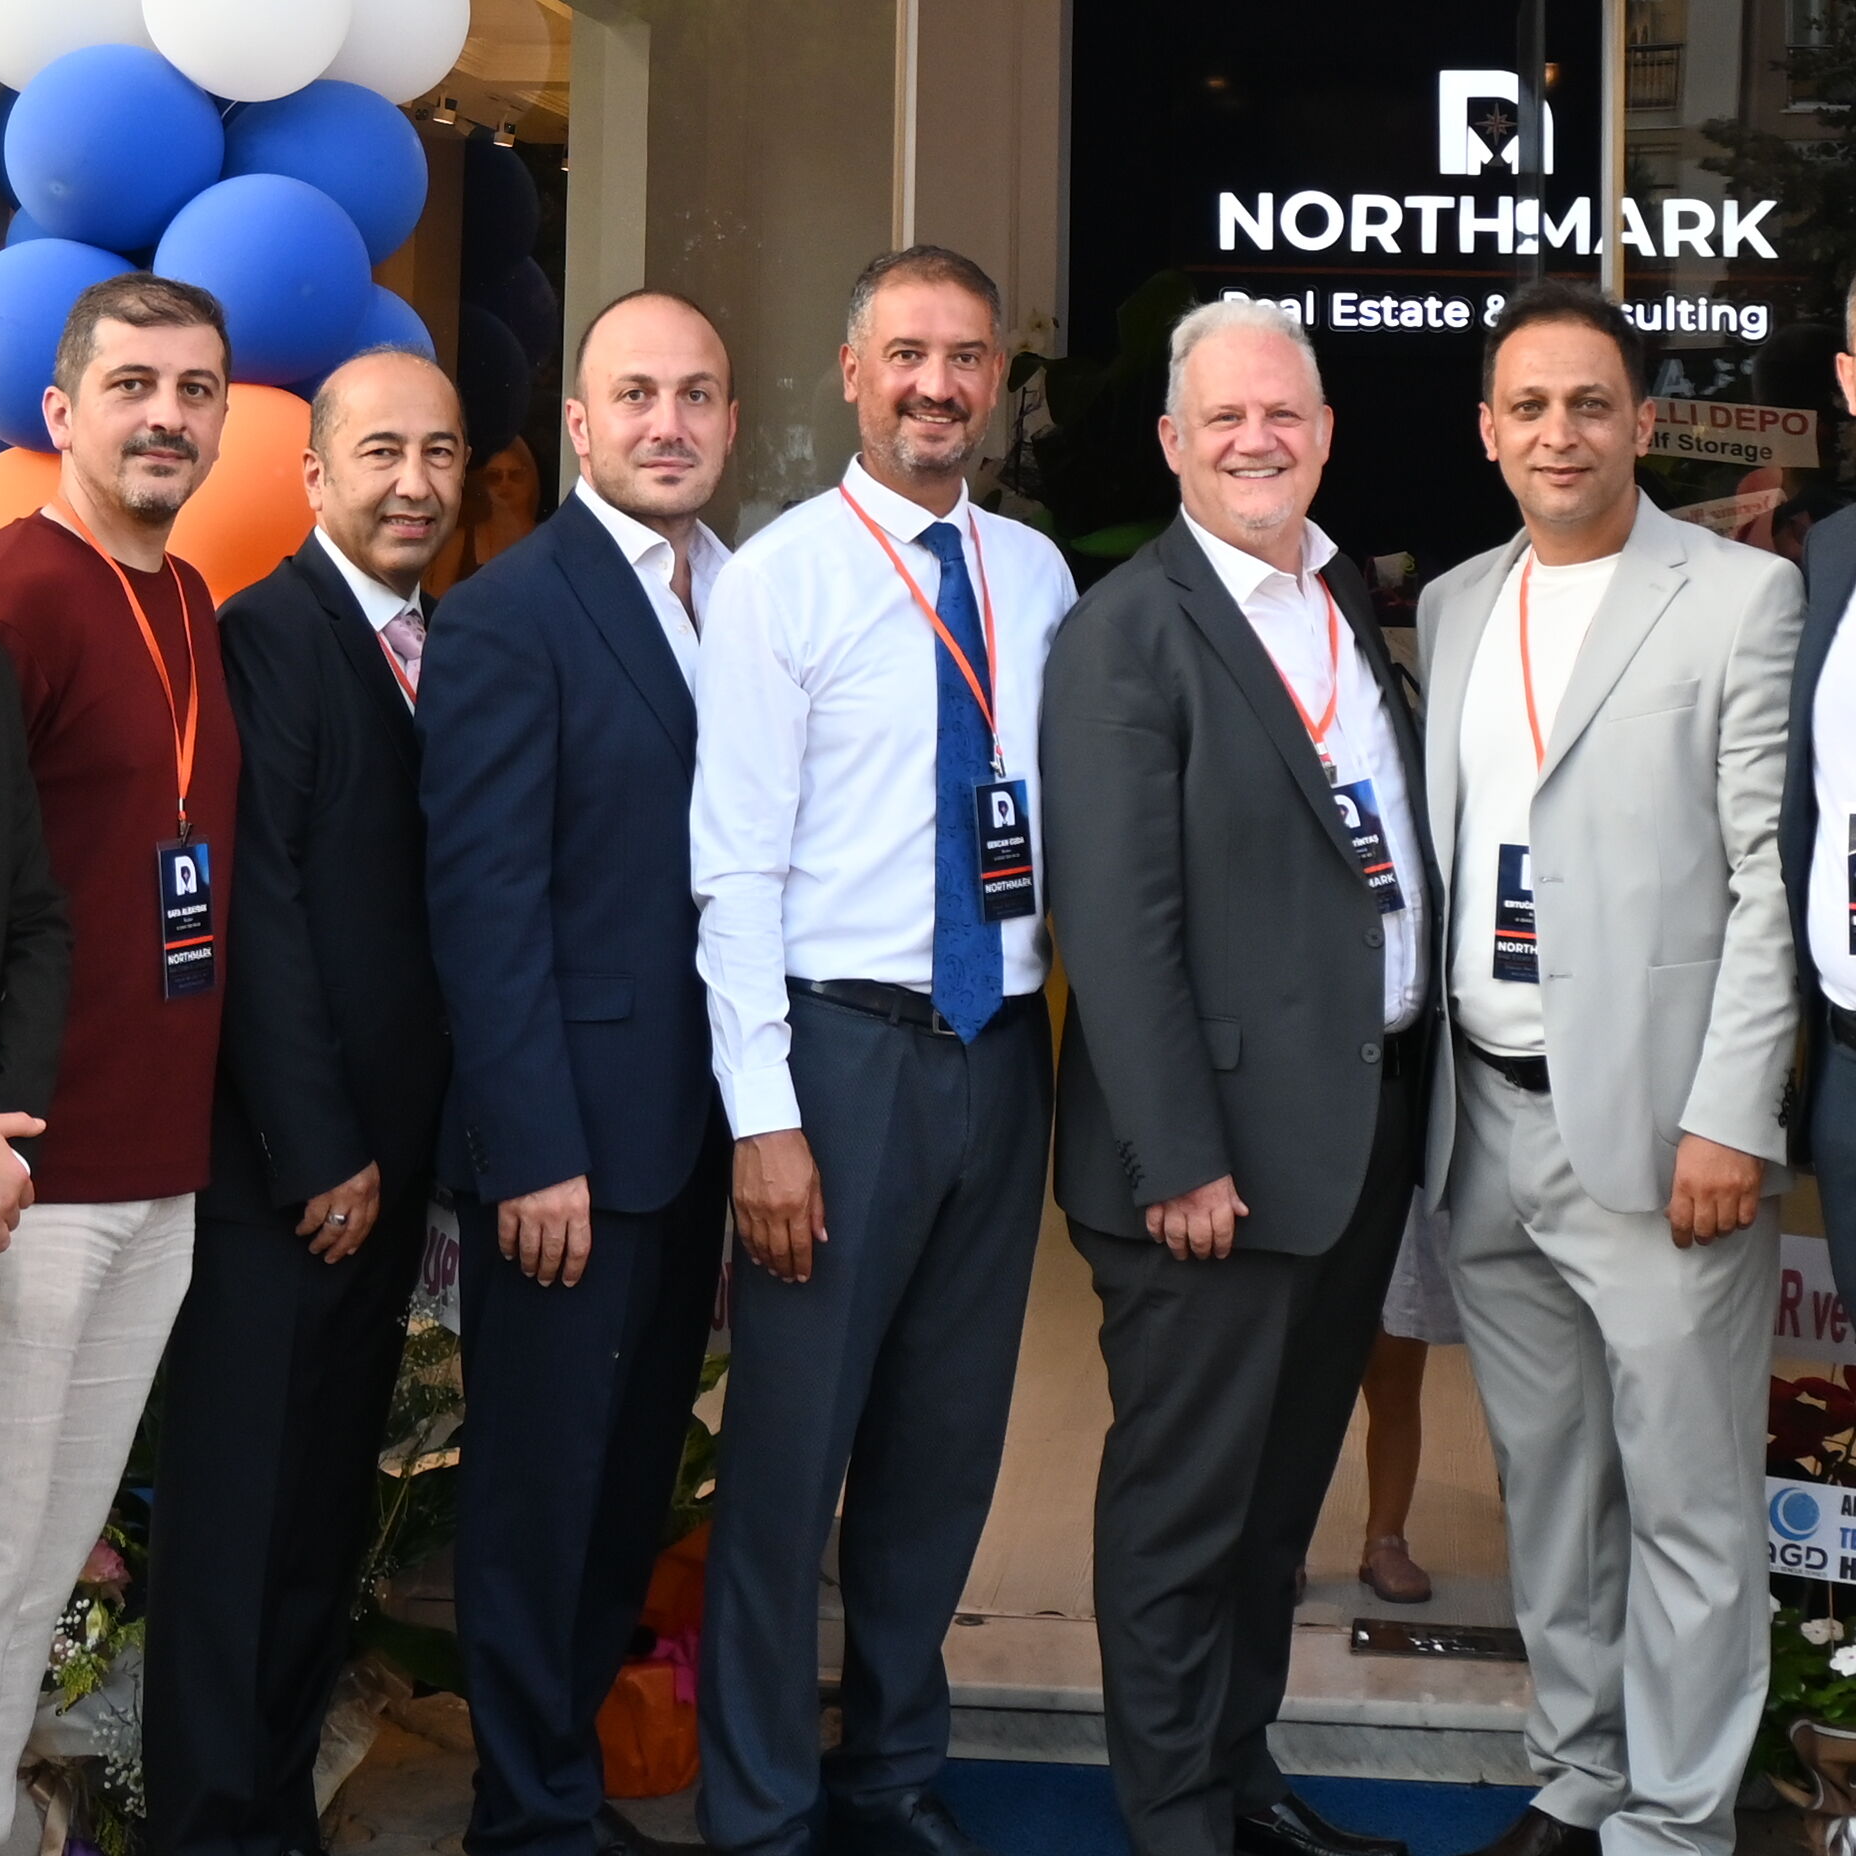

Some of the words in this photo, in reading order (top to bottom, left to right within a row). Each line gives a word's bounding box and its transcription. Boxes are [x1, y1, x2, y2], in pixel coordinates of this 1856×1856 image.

[1217, 190, 1780, 260] NORTHMARK
[1223, 290, 1315, 326] al
[1332, 291, 1471, 328] Estate
[1620, 295, 1769, 341] sulting
[1709, 404, 1810, 437] DEPO
[1677, 432, 1774, 462] Storage
[167, 947, 212, 966] NORTHMARK
